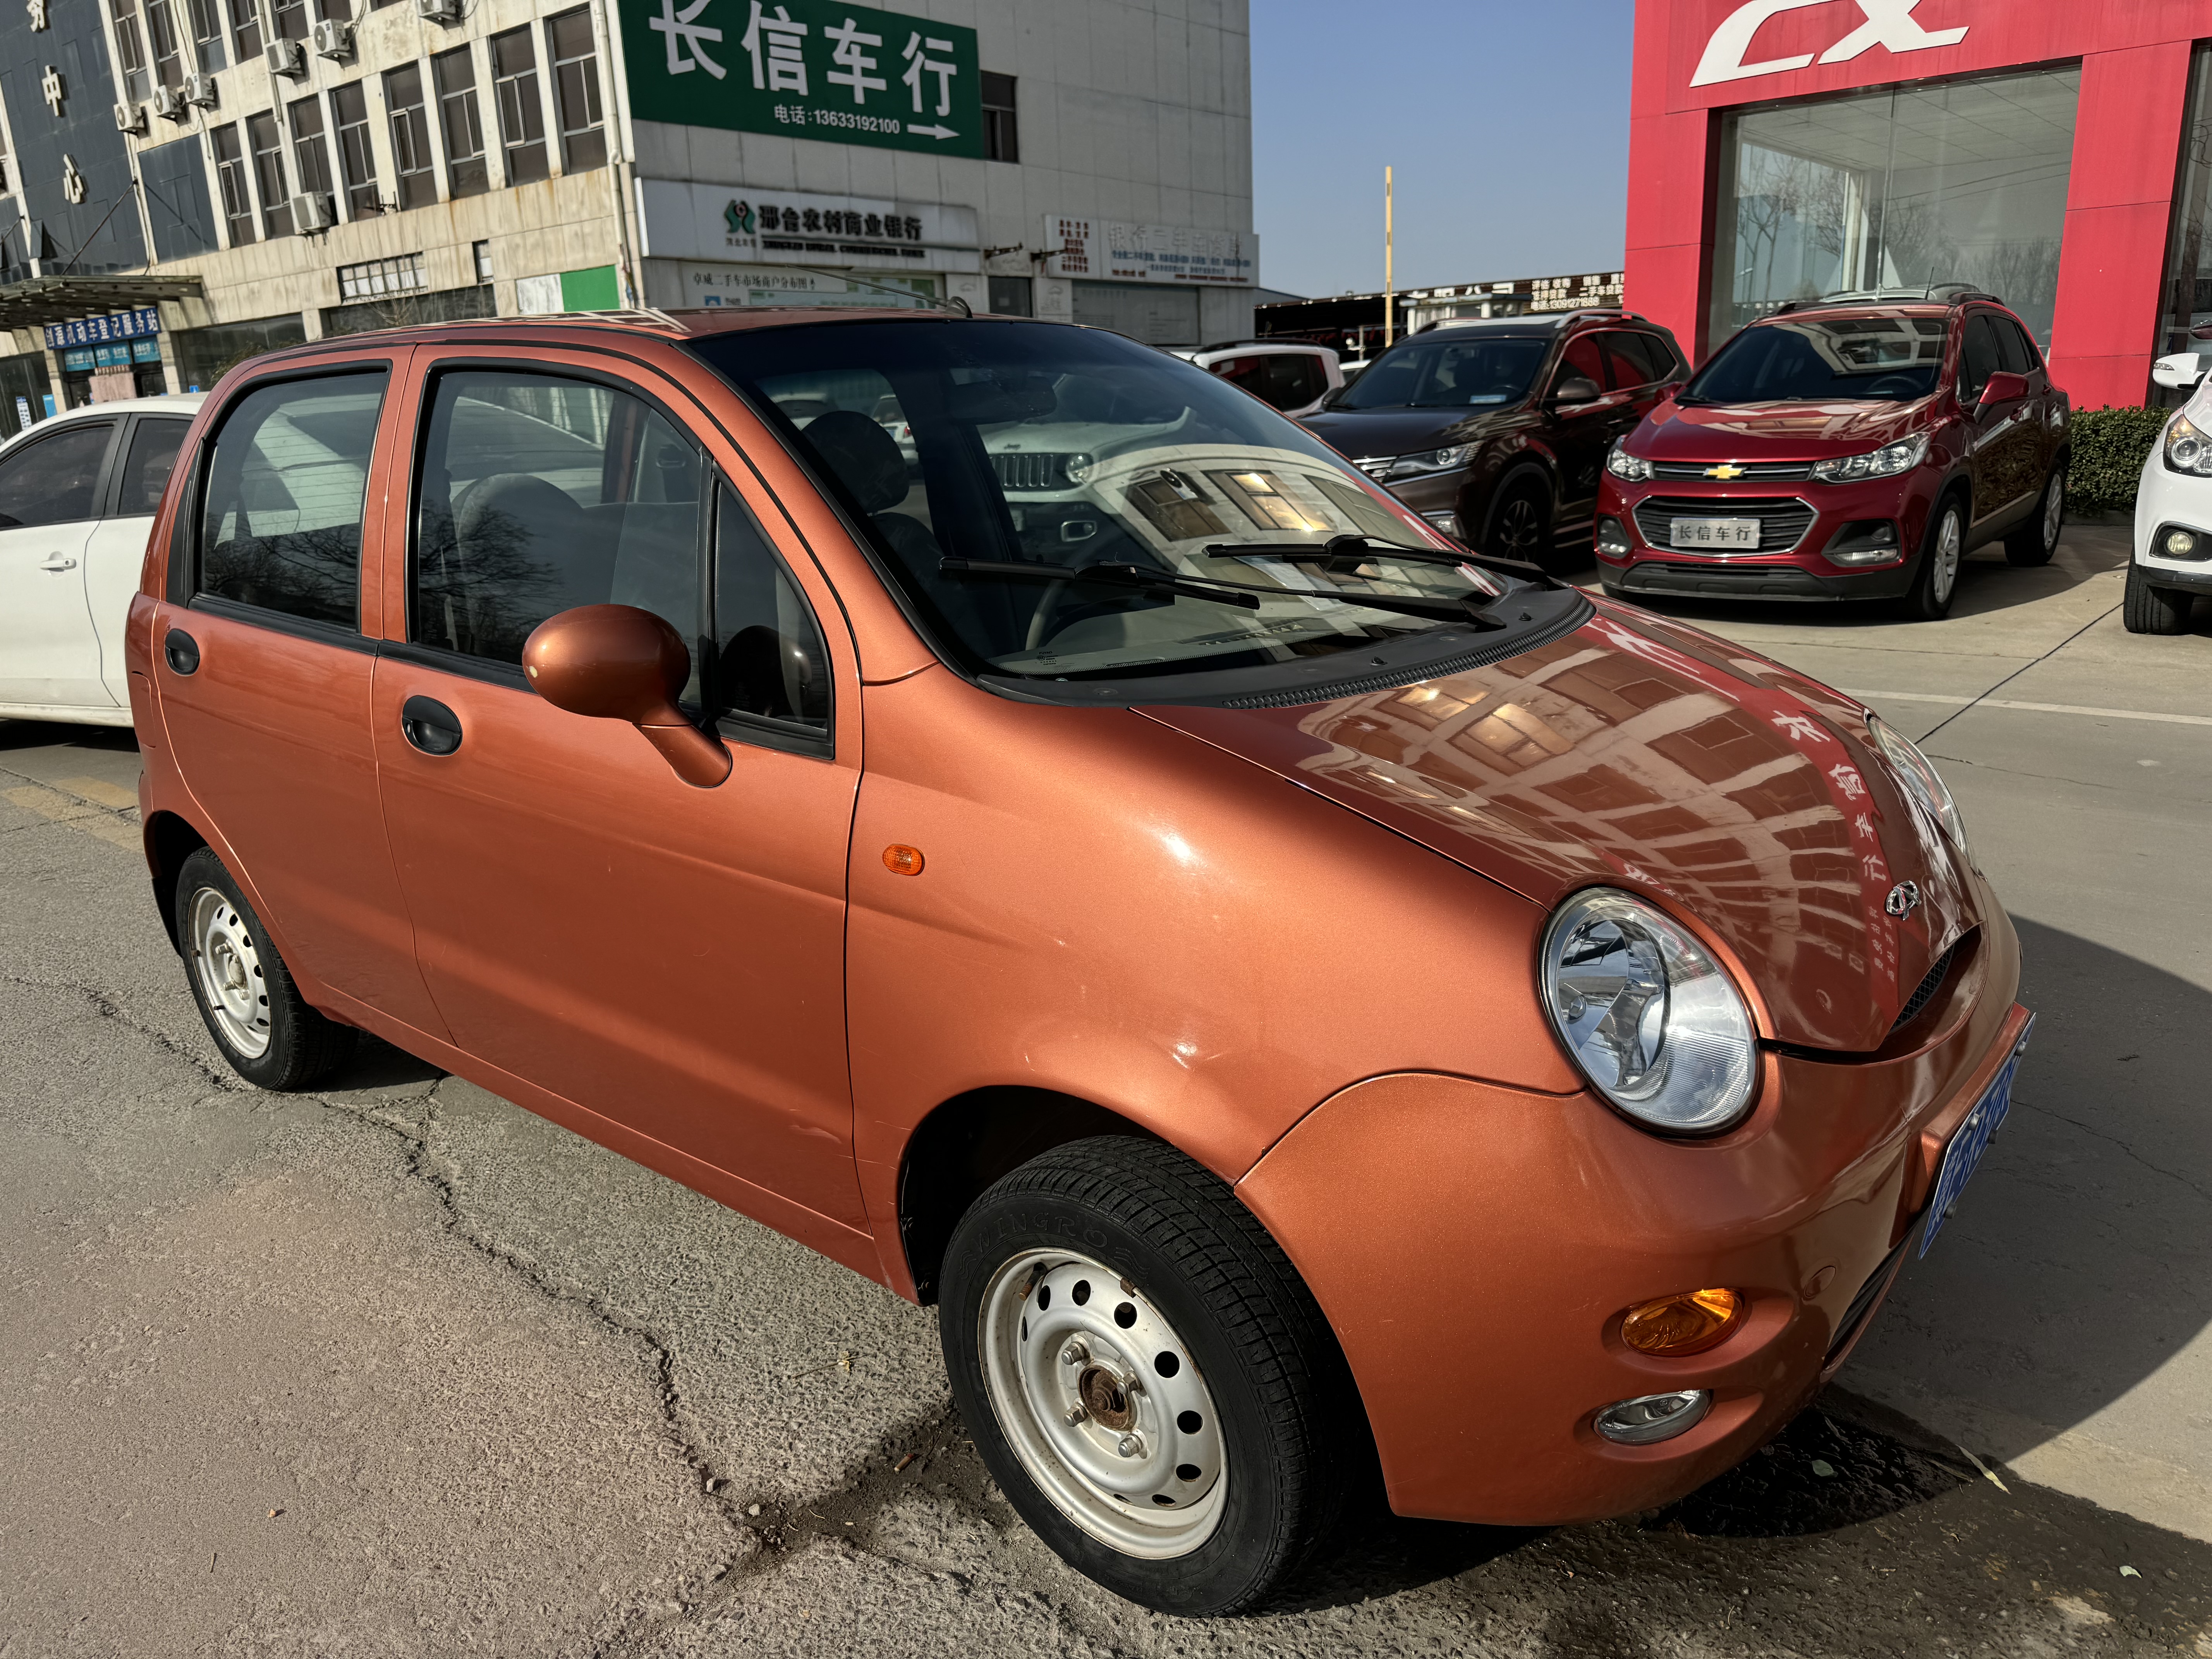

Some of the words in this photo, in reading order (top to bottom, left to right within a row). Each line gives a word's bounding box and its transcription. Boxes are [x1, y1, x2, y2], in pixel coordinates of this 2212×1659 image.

[649, 0, 957, 117] 长信车行
[759, 205, 923, 241] 邢台农村商业银行
[1678, 525, 1752, 541] 长信车行
